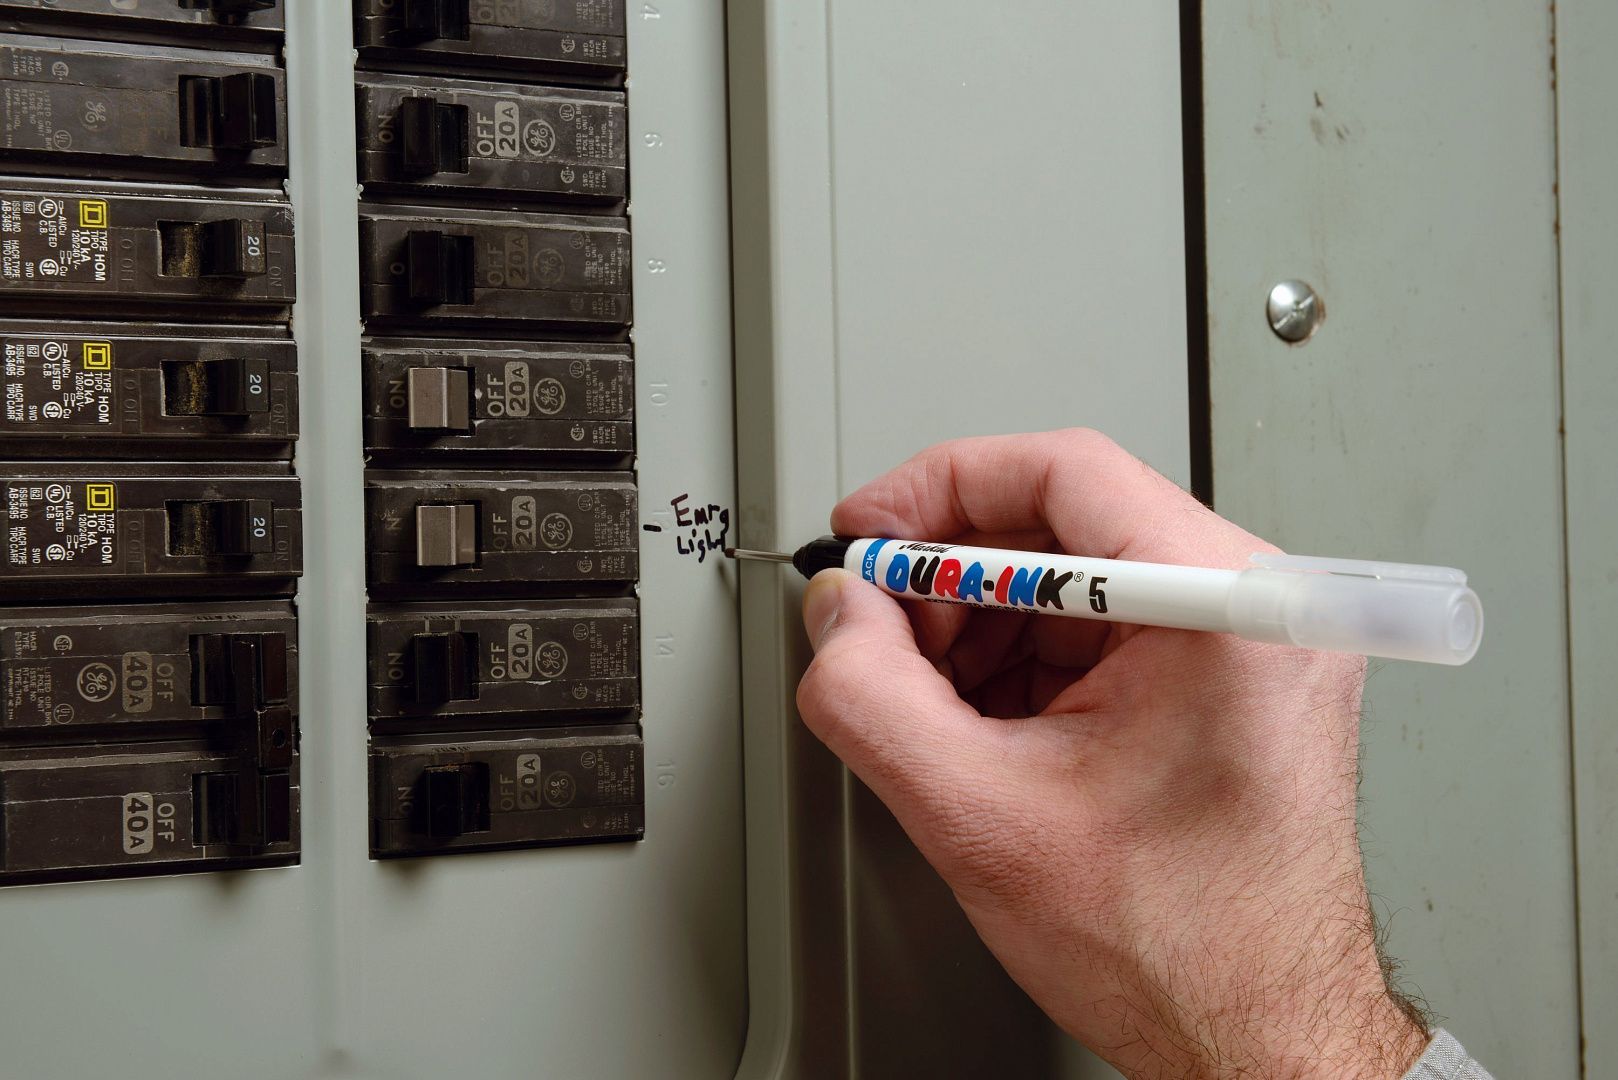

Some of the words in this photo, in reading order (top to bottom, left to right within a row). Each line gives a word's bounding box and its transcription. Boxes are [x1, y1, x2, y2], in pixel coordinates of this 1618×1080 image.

[378, 114, 394, 143] ON
[477, 112, 494, 156] OFF
[499, 105, 516, 154] 20A
[645, 133, 662, 148] 6
[1, 200, 11, 232] AB-3495
[12, 201, 21, 221] ISSUE
[25, 203, 33, 212] 62
[13, 222, 21, 234] NO.
[49, 221, 57, 247] LISTED
[80, 230, 90, 244] 10
[3, 240, 11, 255] TIPO
[11, 240, 19, 259] HACR
[72, 229, 80, 257] 120/240
[91, 231, 99, 249] TIPO
[99, 231, 107, 251] TYPE
[248, 236, 260, 256] 20
[81, 248, 91, 262] kA
[487, 243, 504, 285] OFF
[509, 236, 526, 282] 20A
[12, 261, 20, 278] TYPE
[26, 262, 34, 277] SWD
[60, 266, 67, 276] Cu
[95, 254, 105, 280] HOM
[648, 258, 666, 274] 8
[6, 344, 16, 375] AB-3495
[16, 345, 24, 364] ISSUE
[29, 346, 37, 355] 62
[17, 366, 25, 377] NO.
[43, 363, 51, 378] C.B.
[84, 372, 93, 386] 10
[7, 384, 15, 399] TIPO
[15, 384, 23, 402] HACR
[103, 372, 111, 393] TYPE
[250, 375, 262, 395] 20
[509, 366, 526, 412] 20A
[84, 390, 94, 404] kA
[390, 380, 405, 408] ON
[487, 373, 504, 416] OFF
[650, 382, 668, 406] 10
[29, 405, 37, 420] SWD
[63, 409, 71, 418] Cu
[99, 396, 109, 422] HOM
[9, 488, 19, 519] AB-3495
[33, 489, 40, 497] 62
[87, 513, 97, 527] 10
[106, 514, 114, 534] TYPE
[515, 500, 532, 546] 20A
[671, 493, 729, 535] Emrg
[10, 527, 18, 542] TIPO
[18, 527, 26, 545] HACR
[79, 513, 87, 541] 120/240
[253, 517, 266, 538] 20
[493, 512, 507, 548] OFF
[88, 532, 97, 546] kA
[32, 548, 40, 563] SWD
[66, 551, 74, 560] Cu
[102, 537, 112, 563] HOM
[1089, 576, 1108, 614] 5
[512, 628, 529, 675] 20A
[655, 633, 674, 657] 14
[388, 652, 404, 680] ON
[491, 642, 505, 679] OFF
[126, 656, 149, 708] 40A
[156, 662, 174, 702] OFF
[520, 758, 537, 807] 20A
[657, 759, 676, 787] 16
[398, 786, 414, 815] ON
[500, 773, 514, 811] OFF
[127, 797, 149, 849] 40A
[157, 803, 175, 843] OFF
